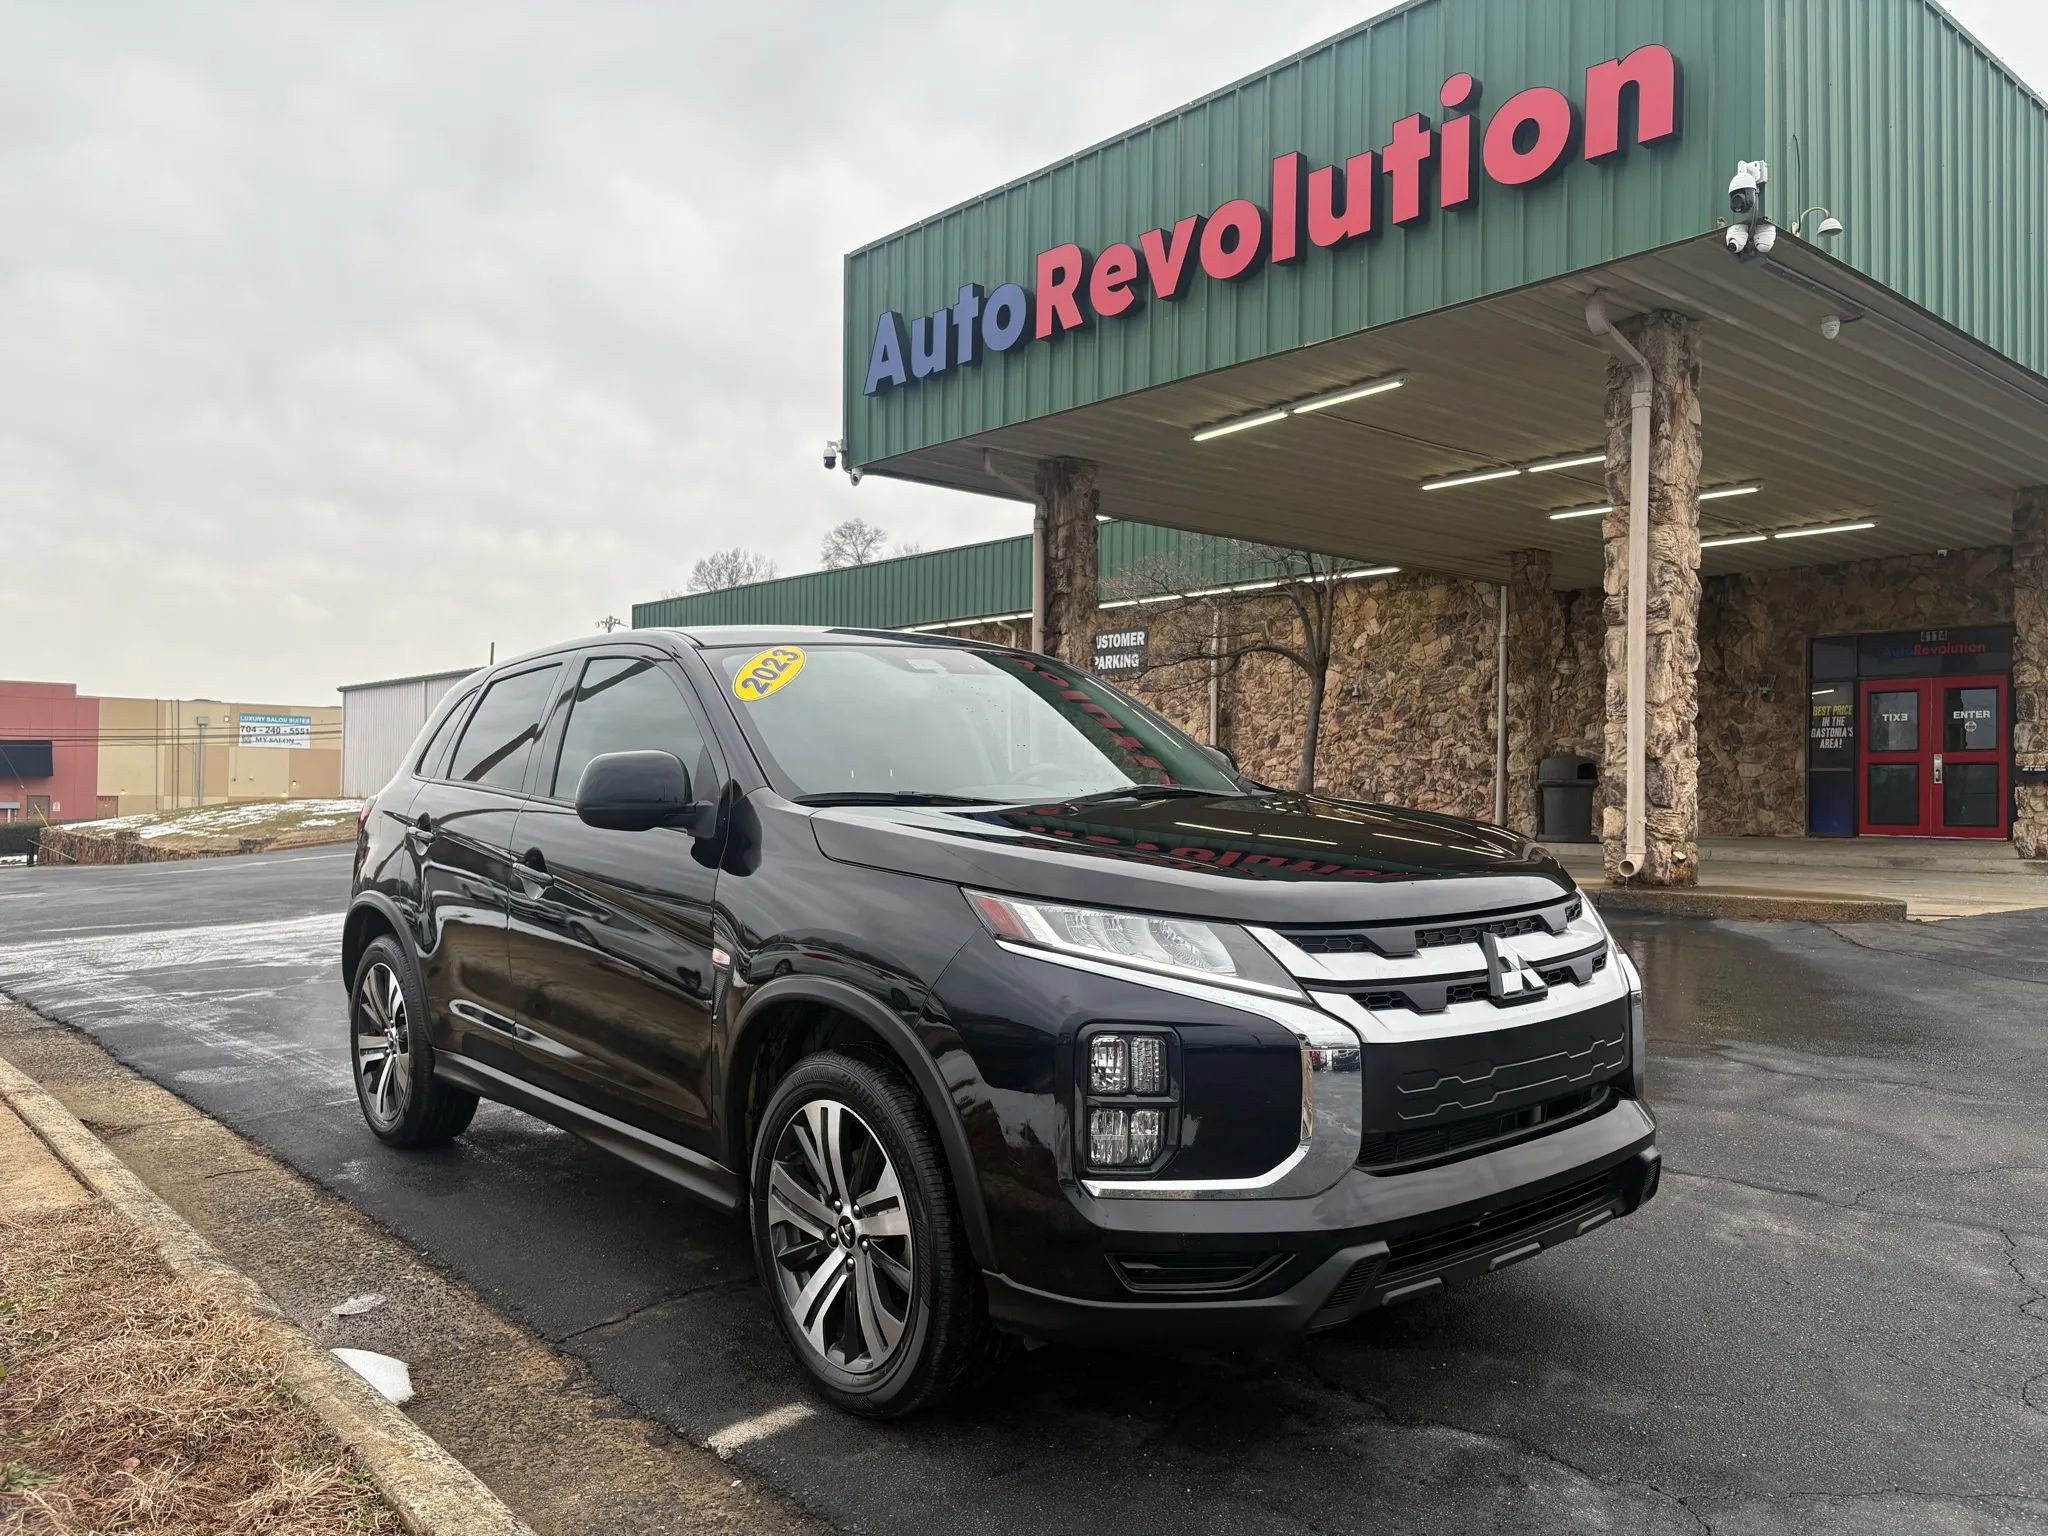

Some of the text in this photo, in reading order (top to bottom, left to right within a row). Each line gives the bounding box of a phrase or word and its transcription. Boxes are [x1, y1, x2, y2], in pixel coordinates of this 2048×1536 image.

[864, 44, 1678, 396] AutoRevolution
[1096, 631, 1145, 649] USTOMER
[741, 649, 798, 694] 2023
[1813, 704, 1853, 716] BEST PRICE
[1953, 710, 1990, 719] ENTER
[1822, 716, 1846, 727] IN THE
[1810, 726, 1854, 738] GASTONIA'S
[1819, 738, 1843, 749] AREA!
